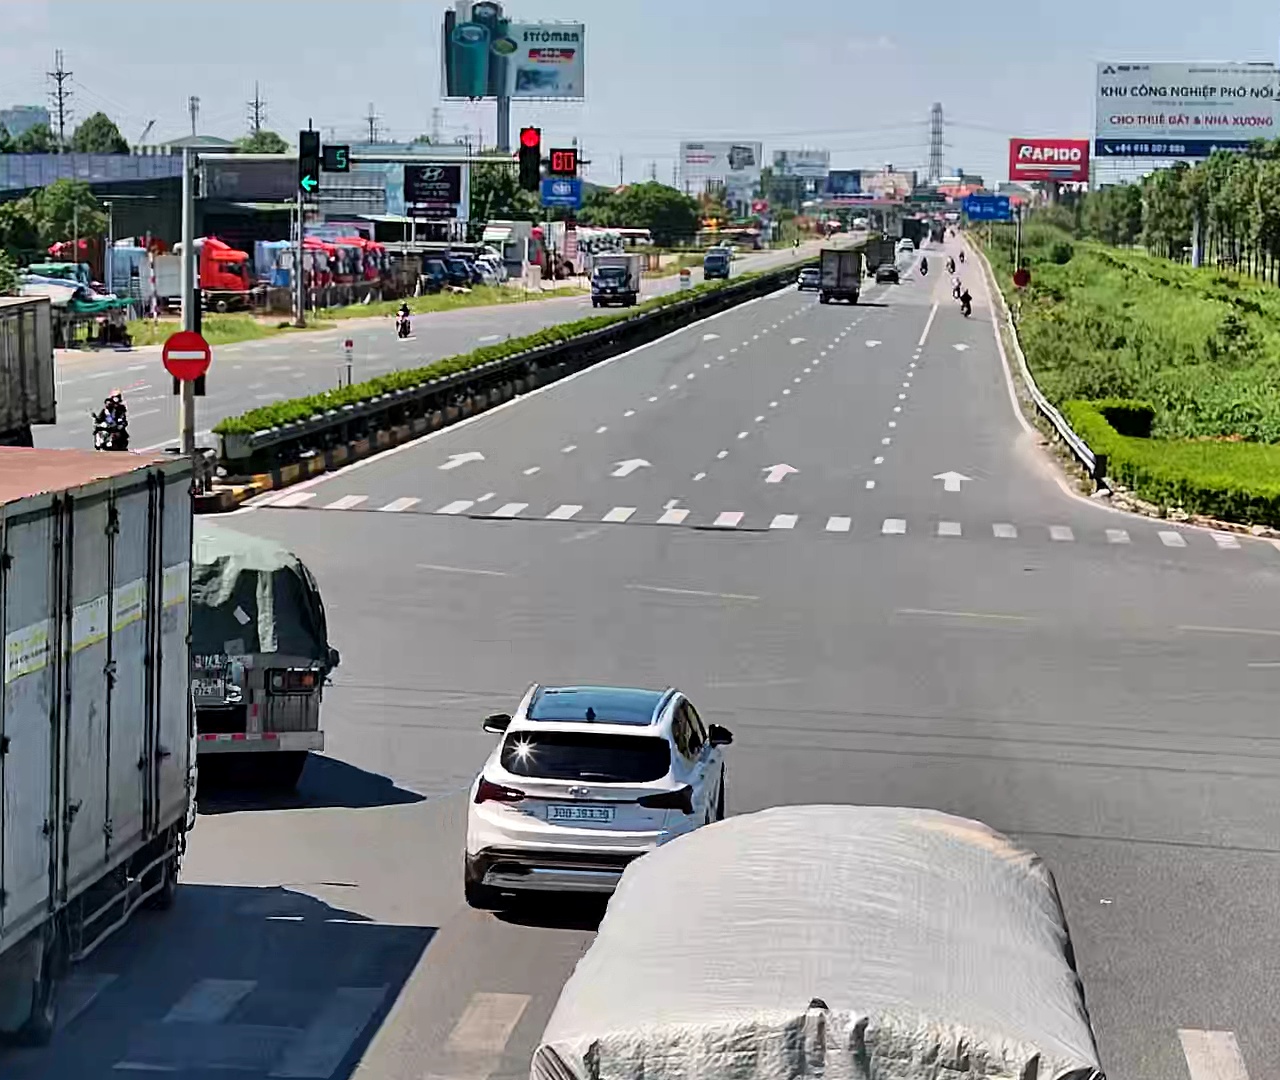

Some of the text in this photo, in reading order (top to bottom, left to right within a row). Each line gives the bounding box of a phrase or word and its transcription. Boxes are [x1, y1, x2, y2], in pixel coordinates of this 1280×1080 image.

[1101, 86, 1127, 97] KHU
[336, 150, 347, 168] 5
[1018, 145, 1081, 160] RAPIDO
